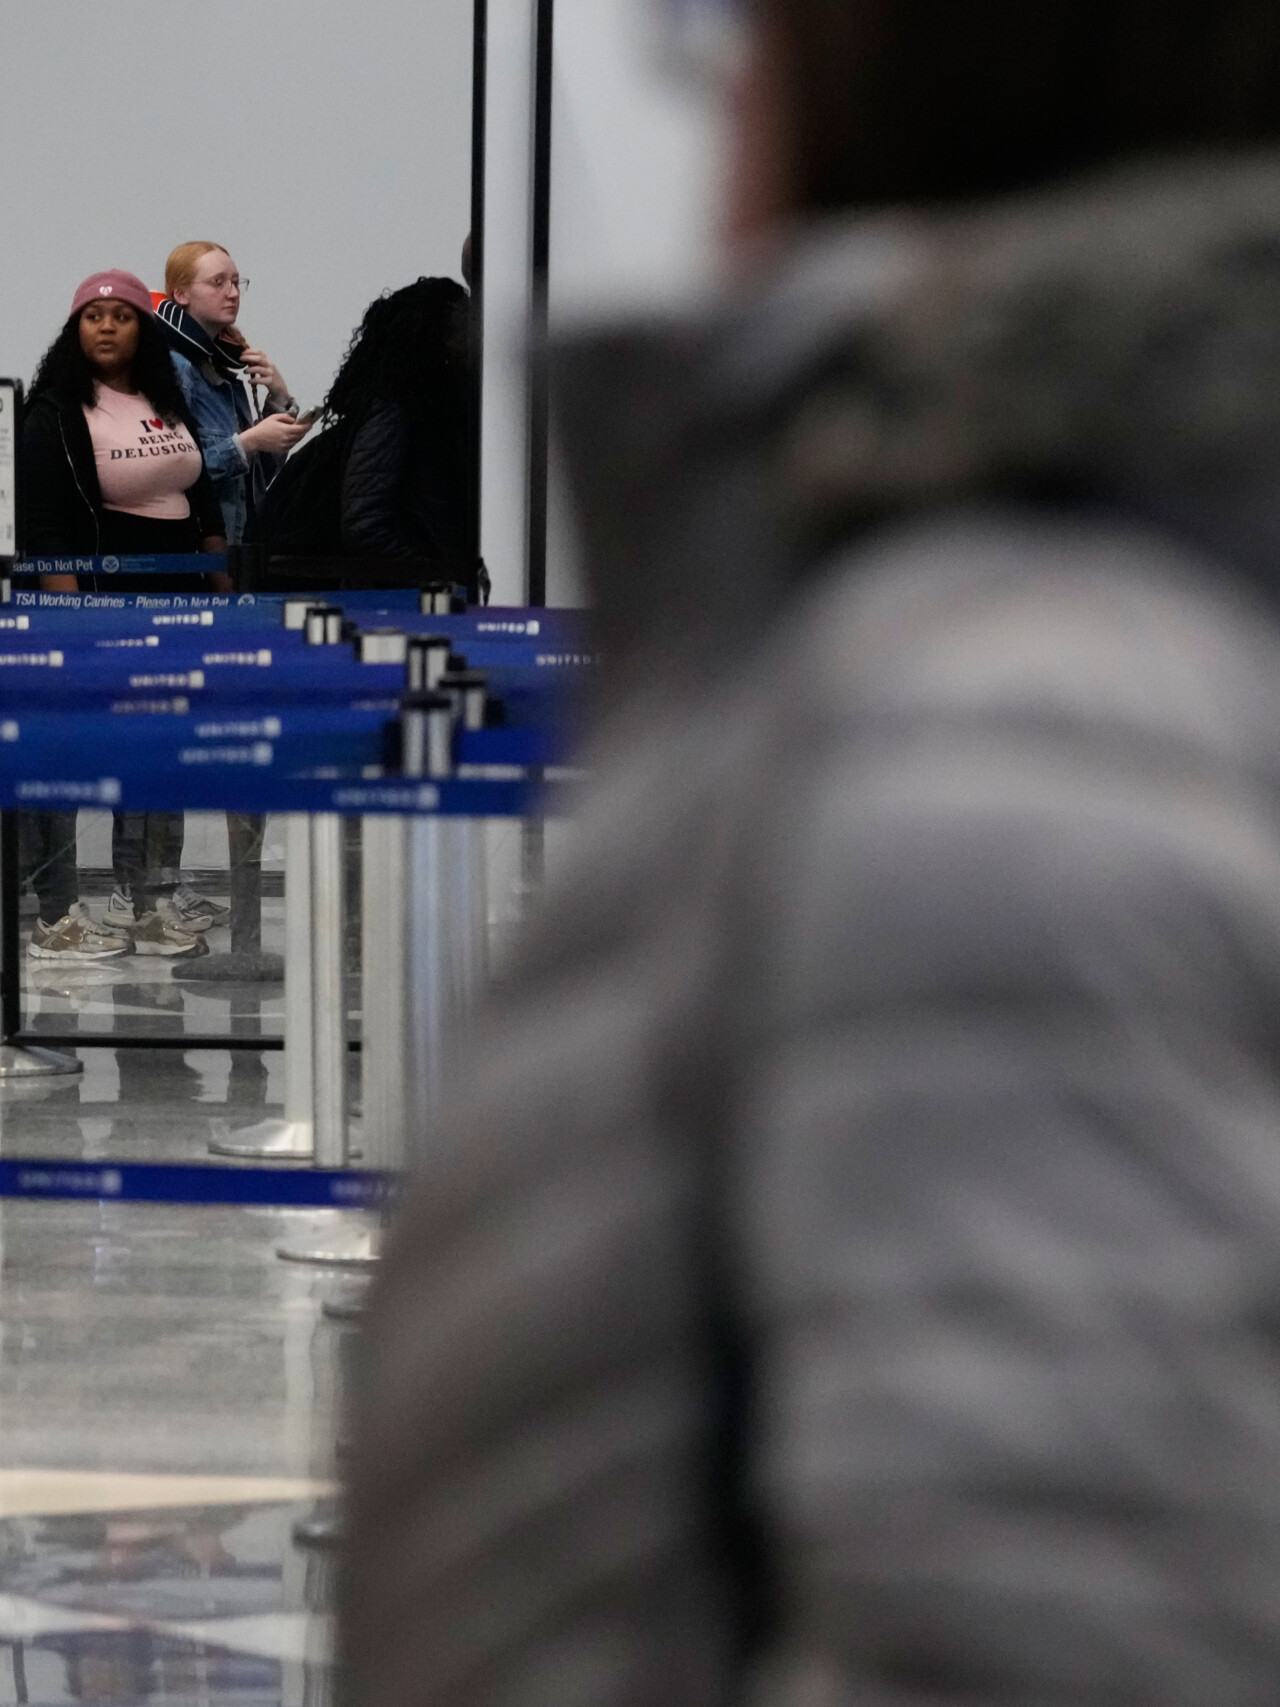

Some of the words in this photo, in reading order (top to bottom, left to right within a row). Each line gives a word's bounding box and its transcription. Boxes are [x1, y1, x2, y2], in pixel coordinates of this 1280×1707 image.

[140, 419, 152, 433] I
[138, 431, 183, 445] BEING
[110, 442, 199, 460] DELUSION
[38, 561, 52, 572] Do
[55, 560, 73, 571] Not
[76, 560, 93, 571] Pet
[16, 593, 37, 606] TSA
[39, 594, 81, 610] Working
[84, 595, 125, 608] Canines
[136, 596, 170, 609] Please
[152, 614, 200, 626] UNITED
[477, 622, 525, 634] UNITED
[202, 652, 257, 665] UNITED
